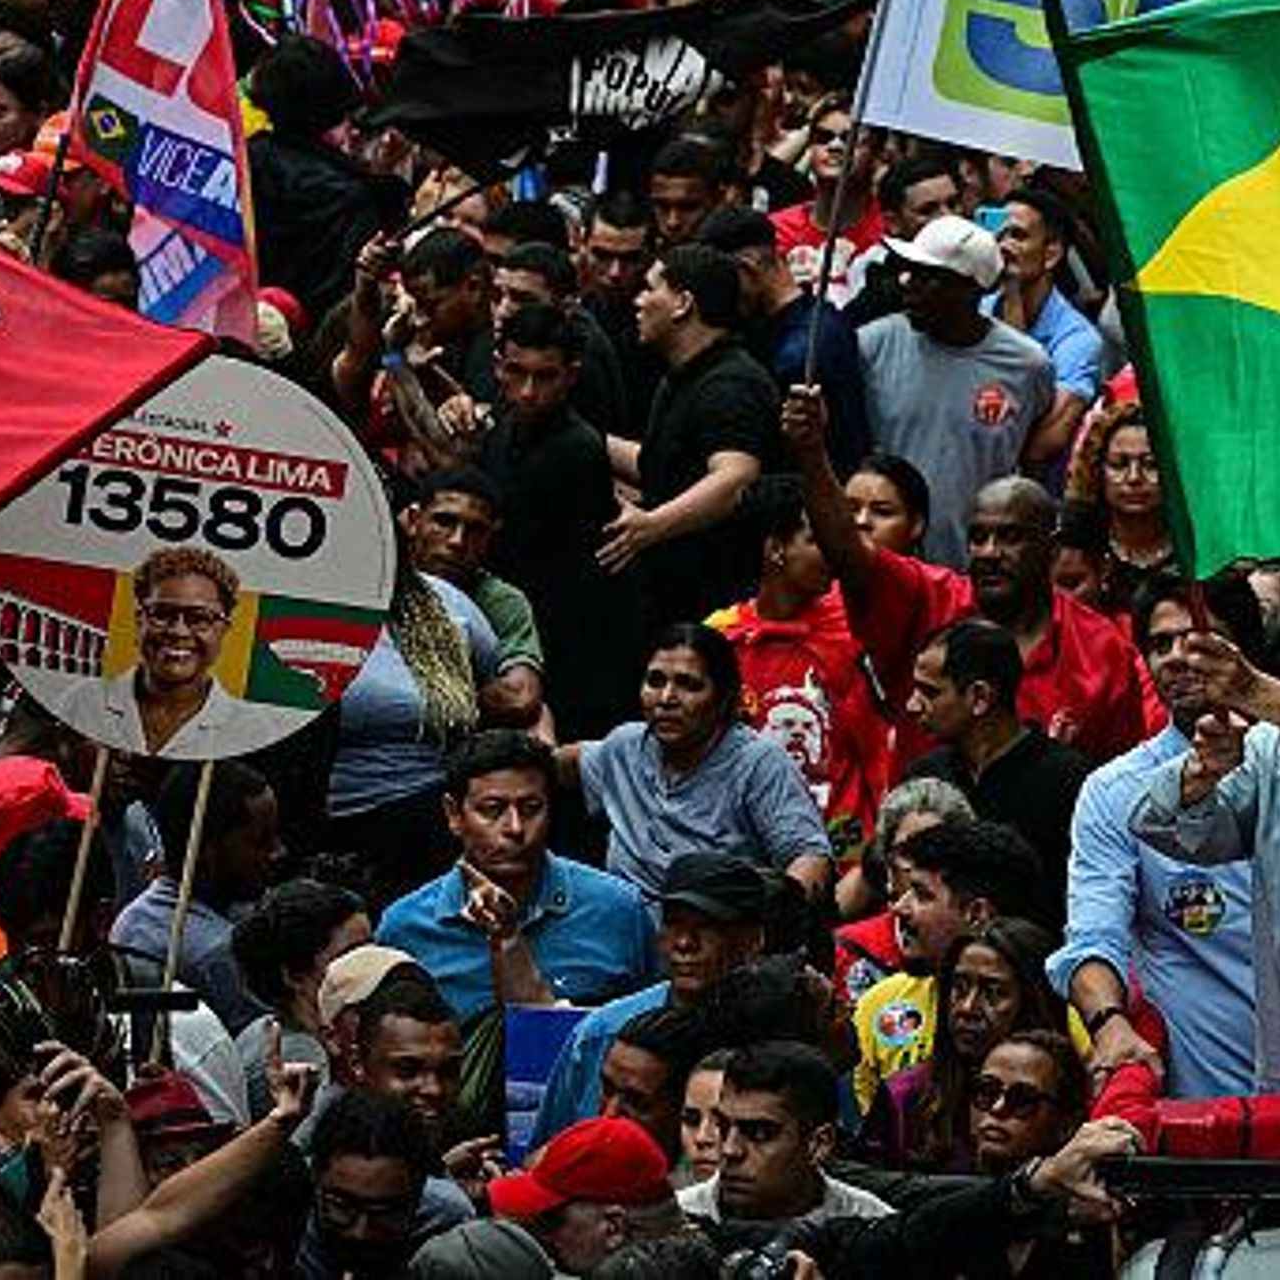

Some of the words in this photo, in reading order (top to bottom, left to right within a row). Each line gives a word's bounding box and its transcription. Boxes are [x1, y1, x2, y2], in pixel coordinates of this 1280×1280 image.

[138, 128, 215, 195] VICE
[81, 431, 241, 479] ERÔNICA
[246, 457, 333, 491] LIMA
[59, 463, 327, 559] 13580
